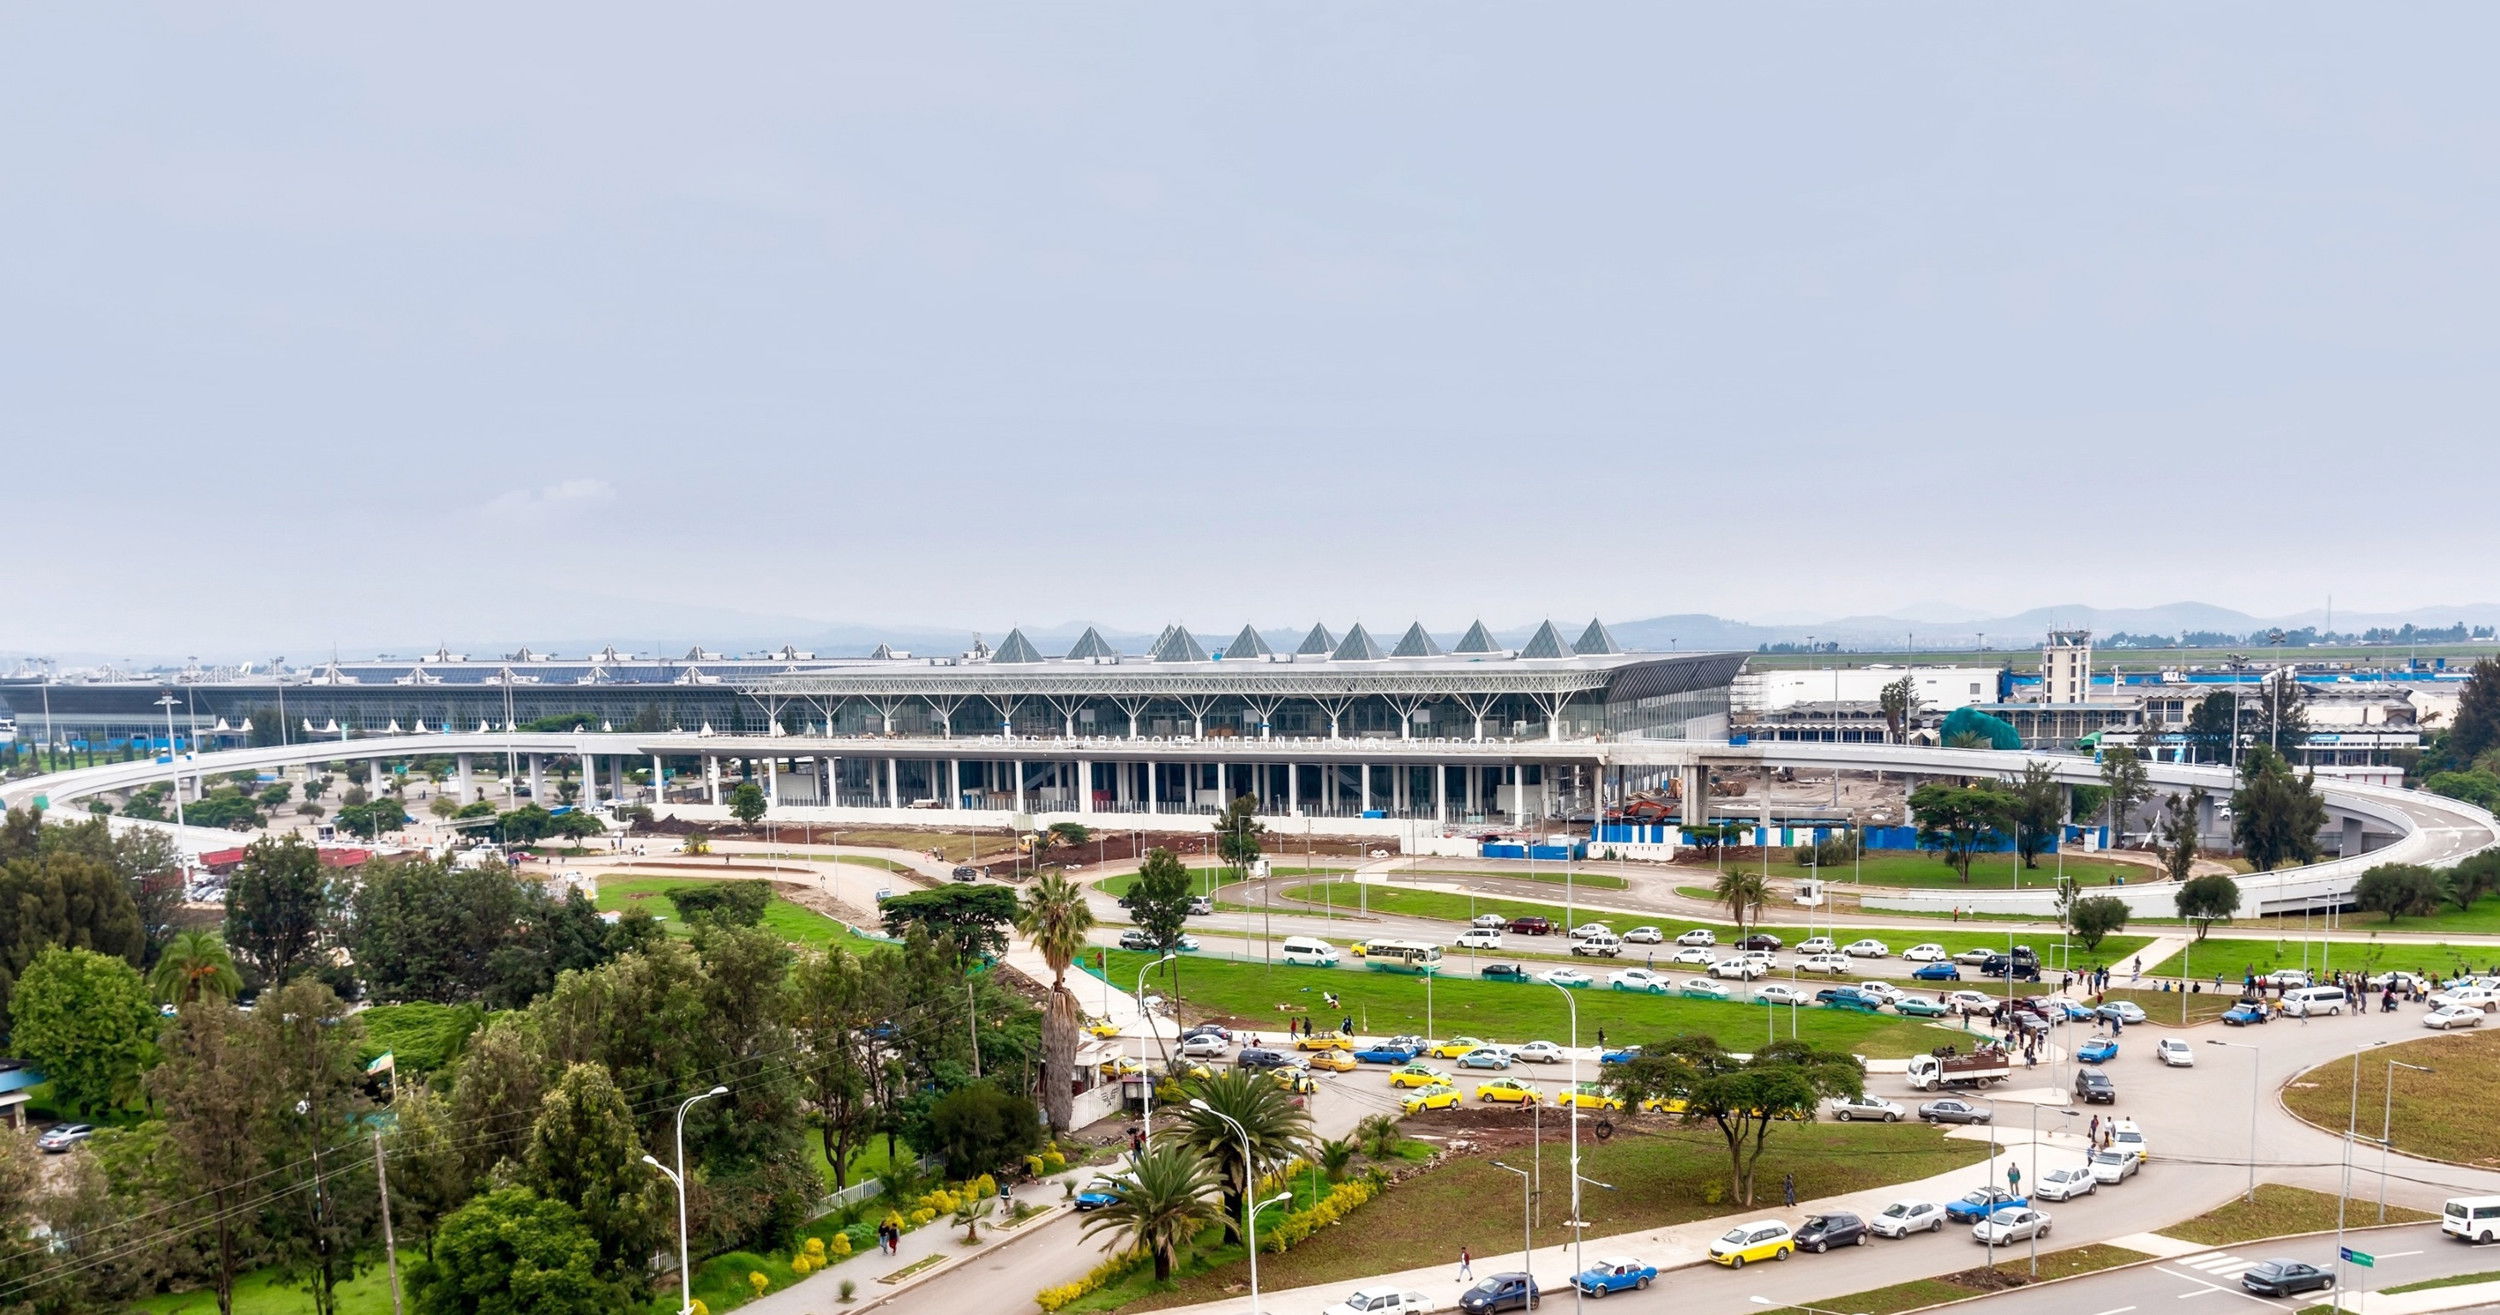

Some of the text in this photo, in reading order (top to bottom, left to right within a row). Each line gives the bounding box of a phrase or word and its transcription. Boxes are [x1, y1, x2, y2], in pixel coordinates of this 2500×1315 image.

[978, 735, 1514, 751] ADDIS ABABA BOLE INTERNATIONAL AIRPORT
